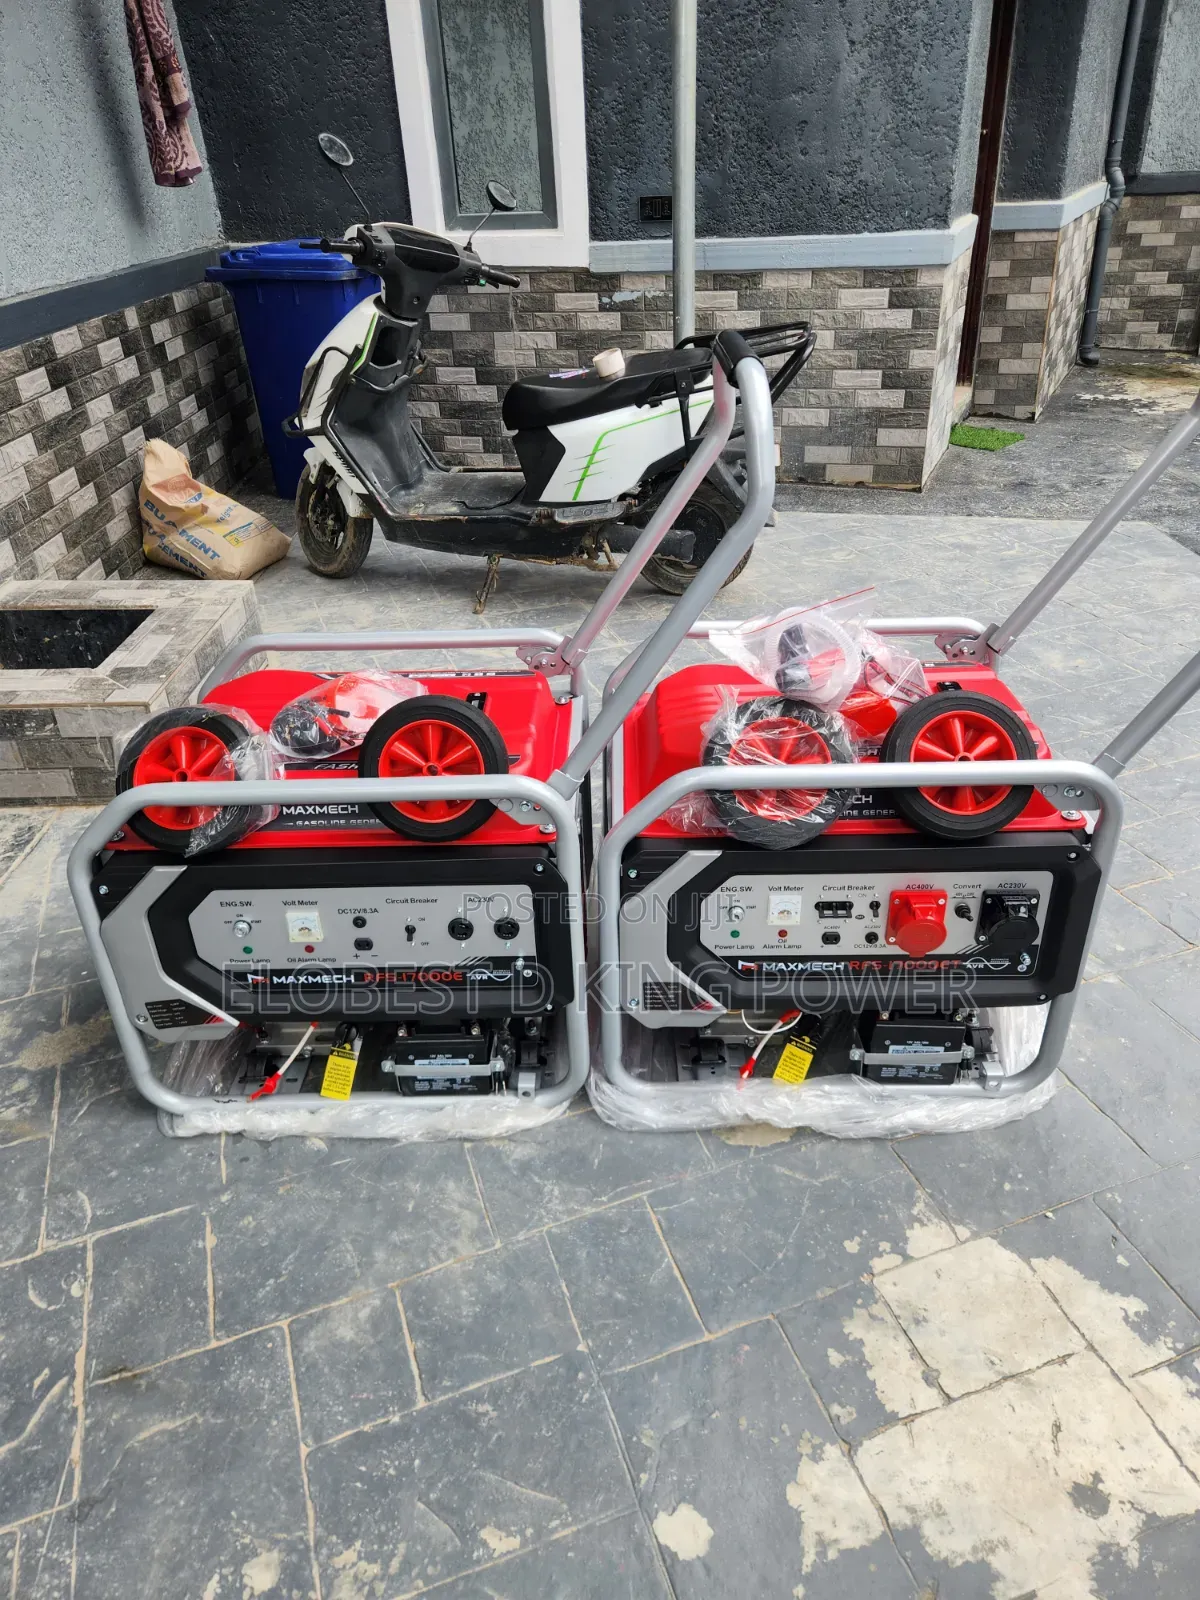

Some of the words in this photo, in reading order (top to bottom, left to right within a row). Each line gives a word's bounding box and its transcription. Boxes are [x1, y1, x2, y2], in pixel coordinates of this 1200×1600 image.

[143, 499, 178, 530] BUA
[282, 804, 359, 815] MAXMECH
[296, 819, 346, 827] GASOLINE
[719, 885, 754, 893] ENG.SW.
[337, 907, 379, 915] DC12V/8.3A
[762, 961, 845, 971] MAXMECH
[272, 975, 355, 984] MAXMECH
[363, 972, 464, 983] RFS-17000E
